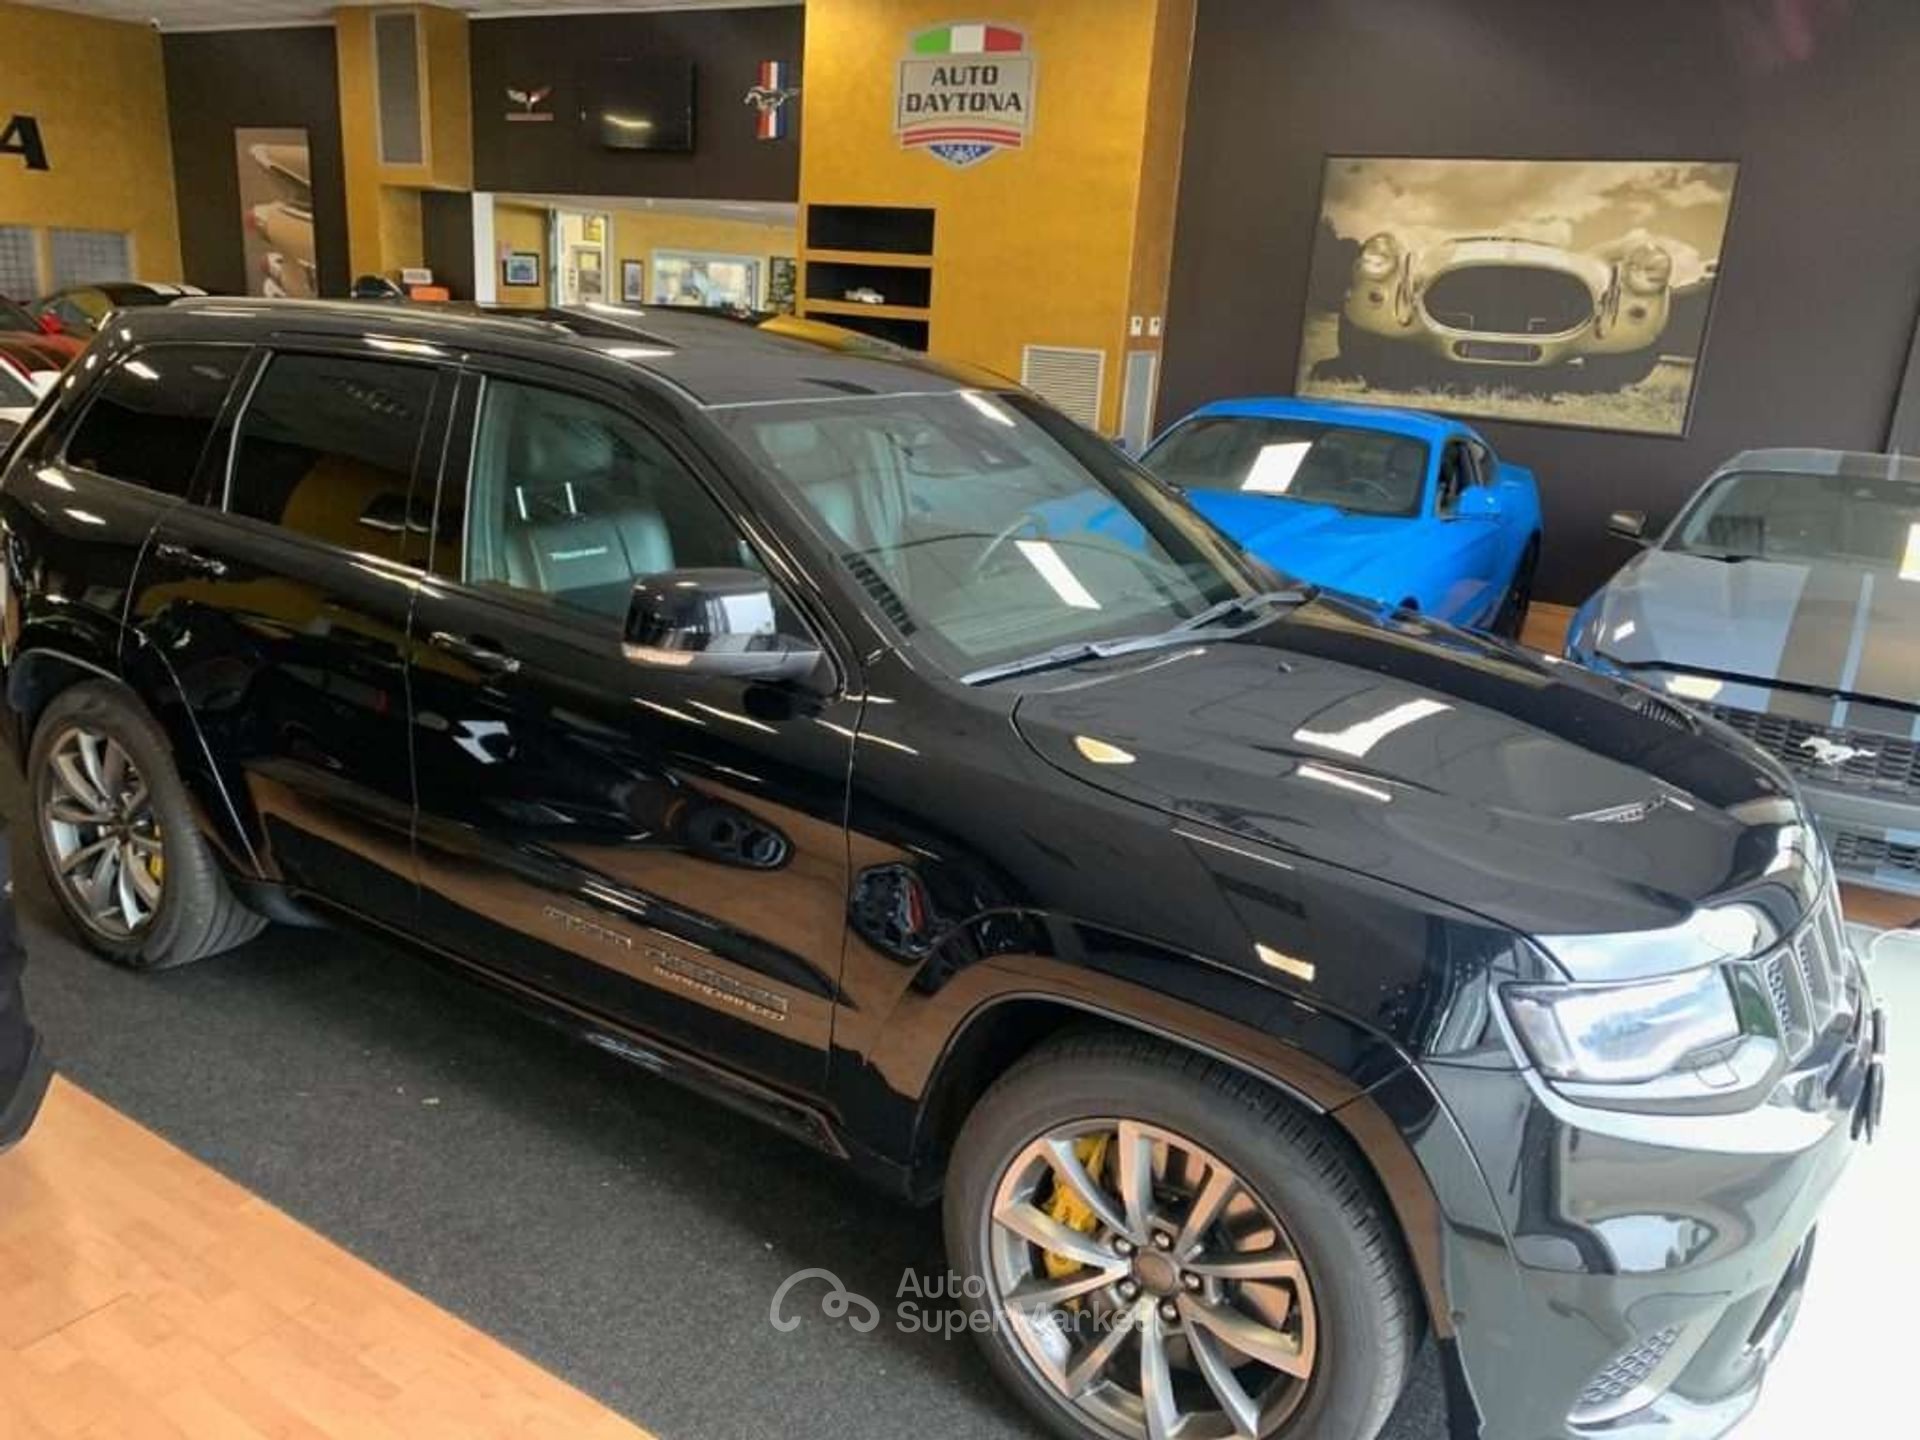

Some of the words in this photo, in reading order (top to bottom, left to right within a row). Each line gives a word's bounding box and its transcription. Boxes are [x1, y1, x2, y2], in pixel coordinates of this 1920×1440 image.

[931, 66, 998, 87] AUTO
[906, 92, 1022, 112] DAYTONA
[0, 115, 50, 171] A
